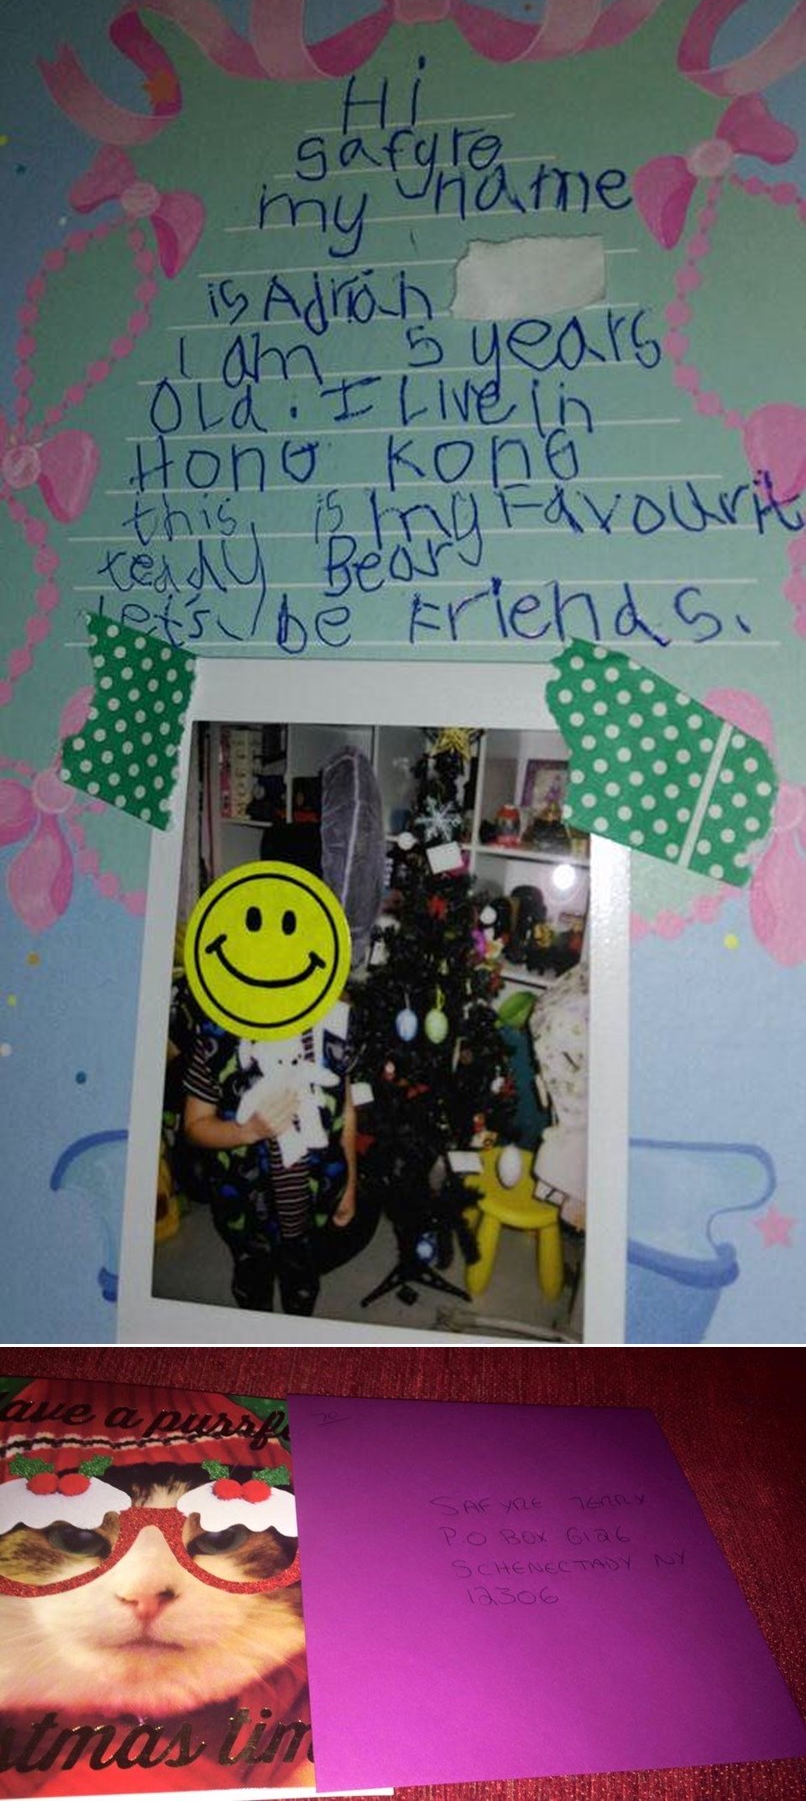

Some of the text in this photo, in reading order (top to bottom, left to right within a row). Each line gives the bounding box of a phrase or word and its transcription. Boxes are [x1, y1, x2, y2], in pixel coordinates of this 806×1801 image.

[342, 54, 425, 135] Hi
[259, 163, 633, 258] my name
[208, 268, 434, 335] is Adrian
[223, 332, 325, 389] am
[407, 324, 444, 368] 5
[472, 308, 662, 395] years
[320, 376, 381, 421] I
[314, 488, 344, 544] is
[370, 487, 483, 566] my
[323, 534, 454, 597] Bear
[277, 592, 351, 654] be
[0, 1392, 290, 1450] ave a purrf
[452, 1550, 687, 1579] SCHENECTADY NY
[500, 1528, 548, 1545] BOX
[566, 1526, 632, 1545] 6126
[466, 1586, 560, 1606] 12306
[218, 1707, 314, 1766] tim
